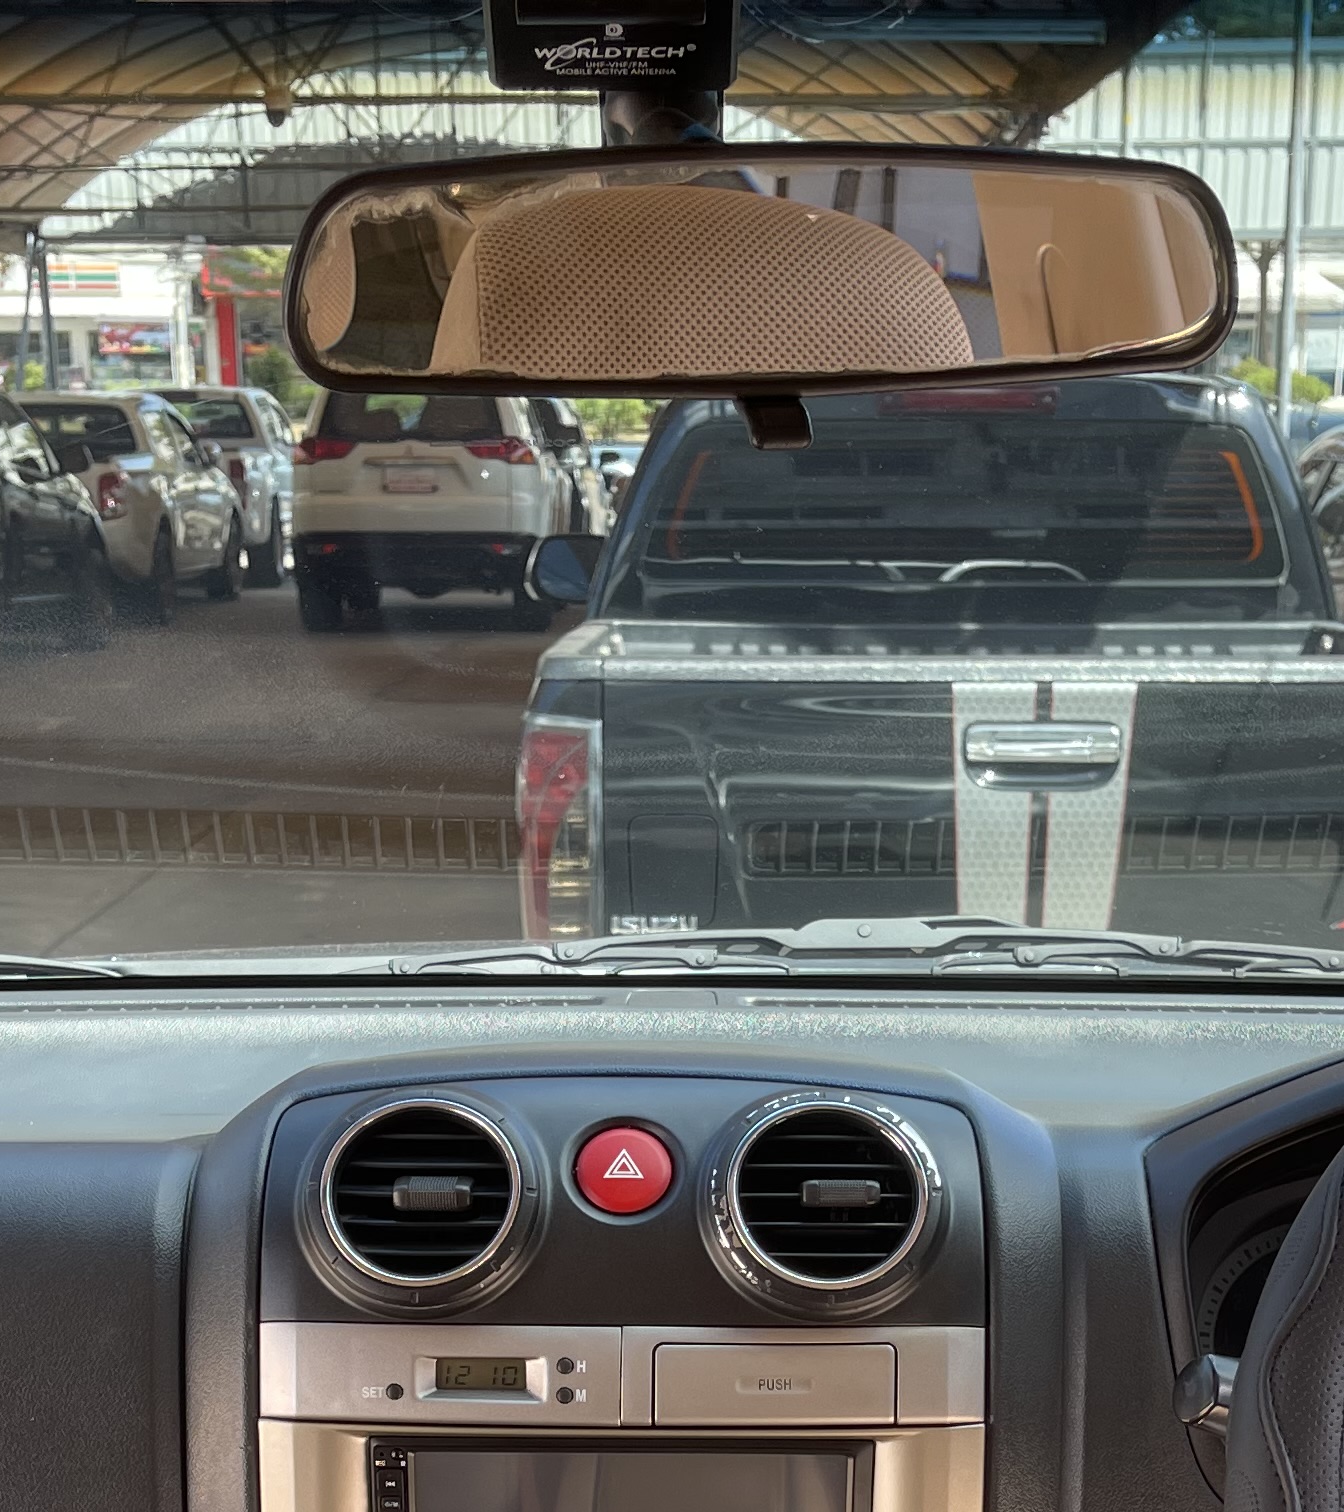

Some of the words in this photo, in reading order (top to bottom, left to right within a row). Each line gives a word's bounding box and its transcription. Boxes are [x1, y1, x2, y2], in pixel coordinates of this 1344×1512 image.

[534, 42, 686, 62] WORLDTECH
[576, 1360, 586, 1373] H
[445, 1366, 470, 1385] 12
[493, 1366, 517, 1386] 10
[758, 1378, 792, 1391] PUSH
[362, 1386, 384, 1399] SET
[576, 1389, 587, 1402] M
